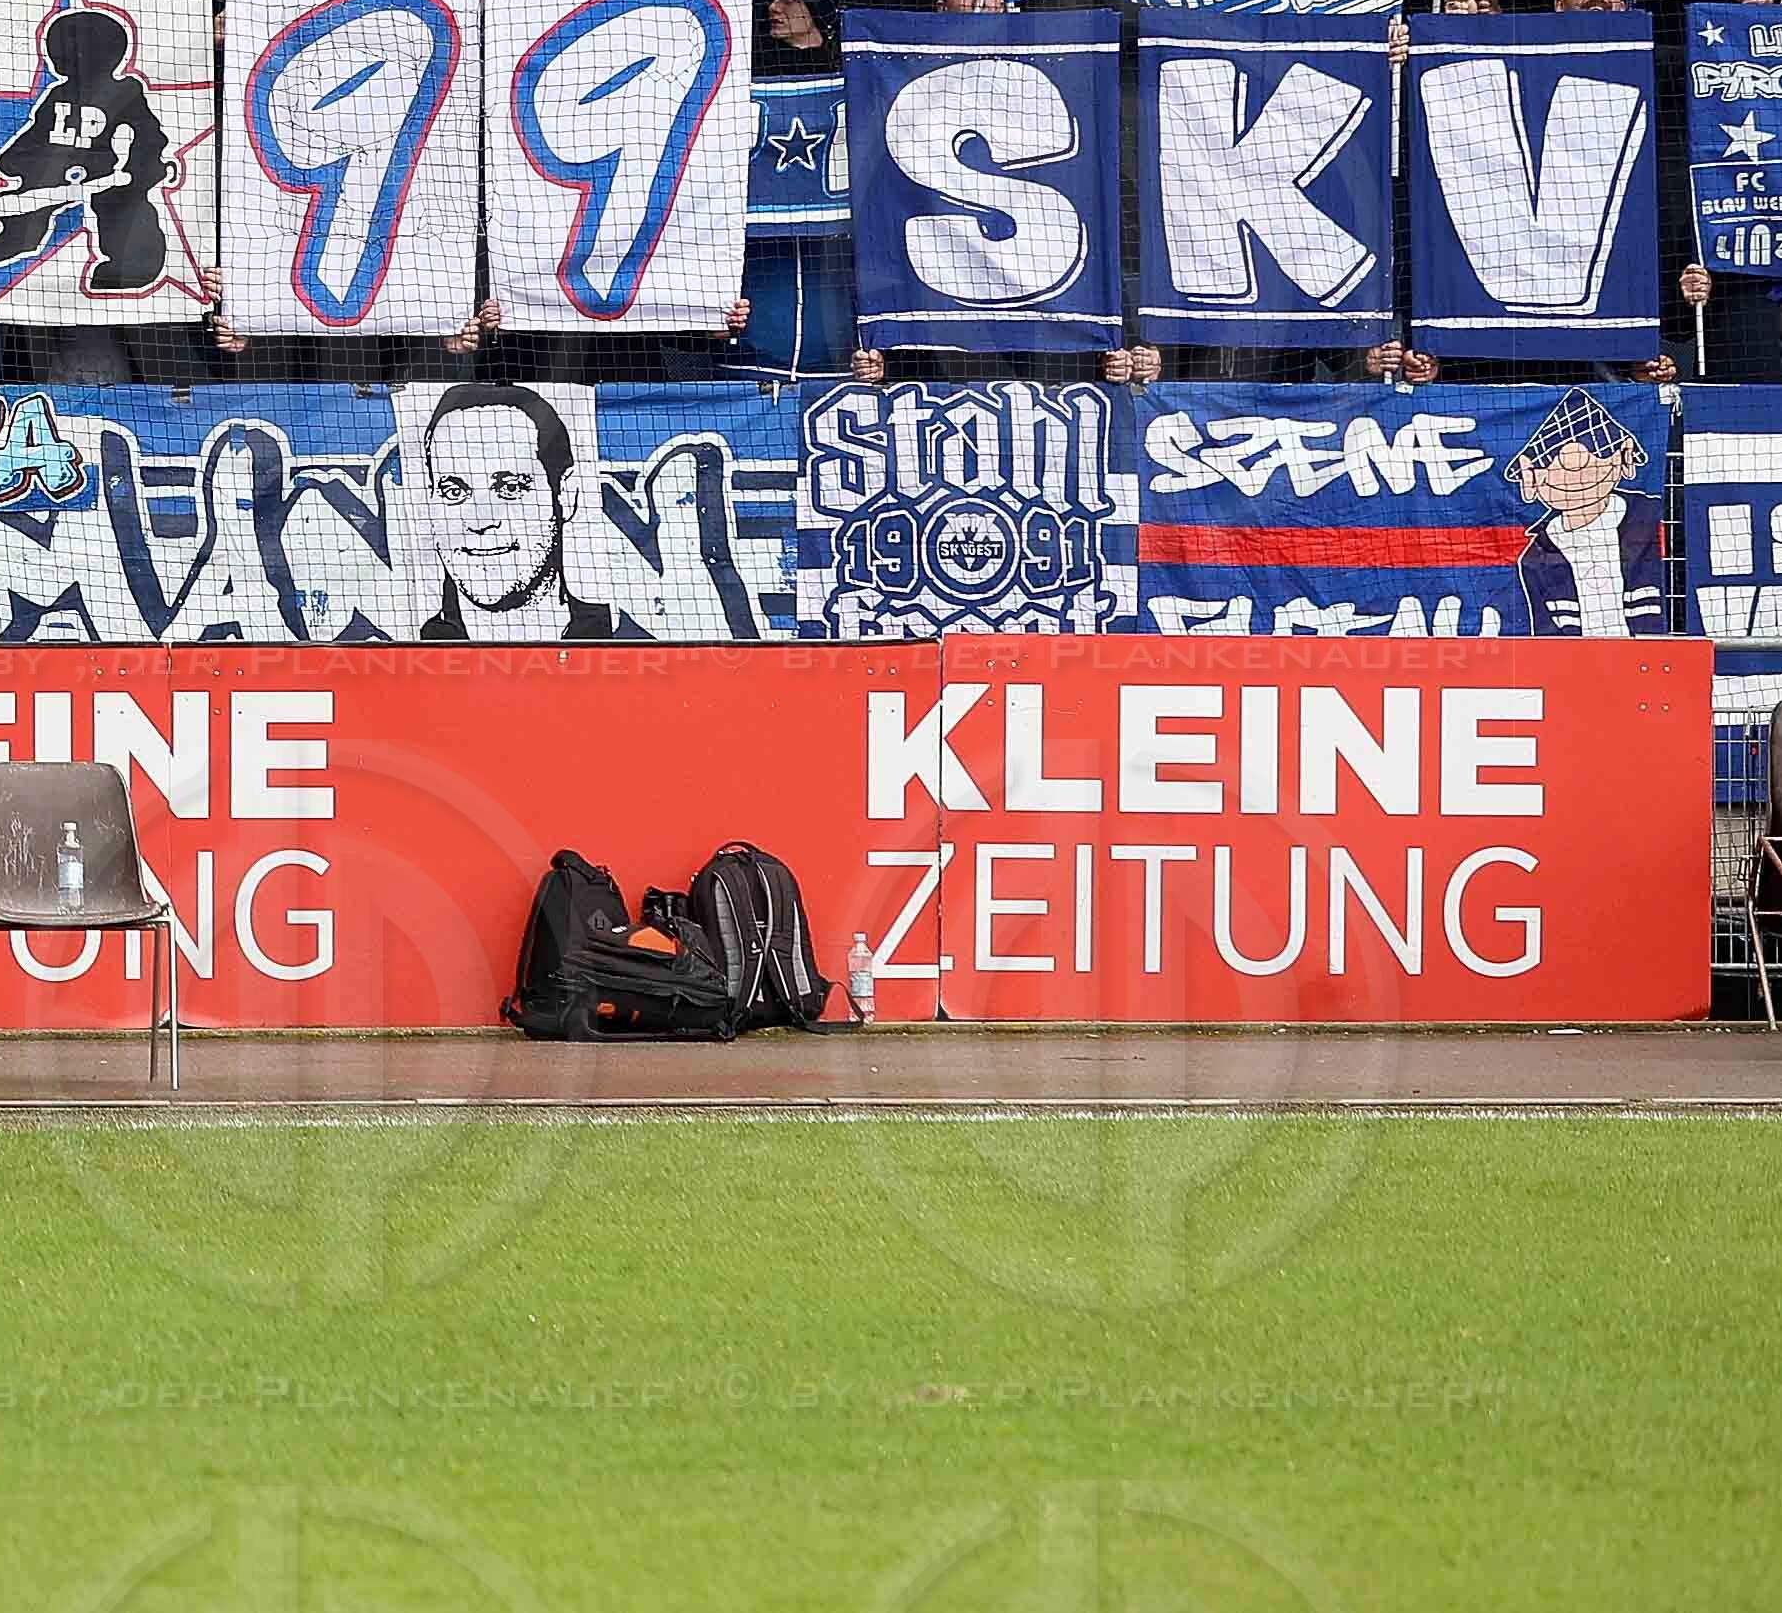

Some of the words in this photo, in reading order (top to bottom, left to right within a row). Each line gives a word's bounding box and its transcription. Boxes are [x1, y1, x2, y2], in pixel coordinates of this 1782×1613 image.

[51, 103, 105, 143] LP
[1736, 172, 1764, 189] FC
[1702, 198, 1746, 214] BLAU
[865, 684, 1545, 819] KLEINE
[869, 844, 1542, 979] ZEITUNG
